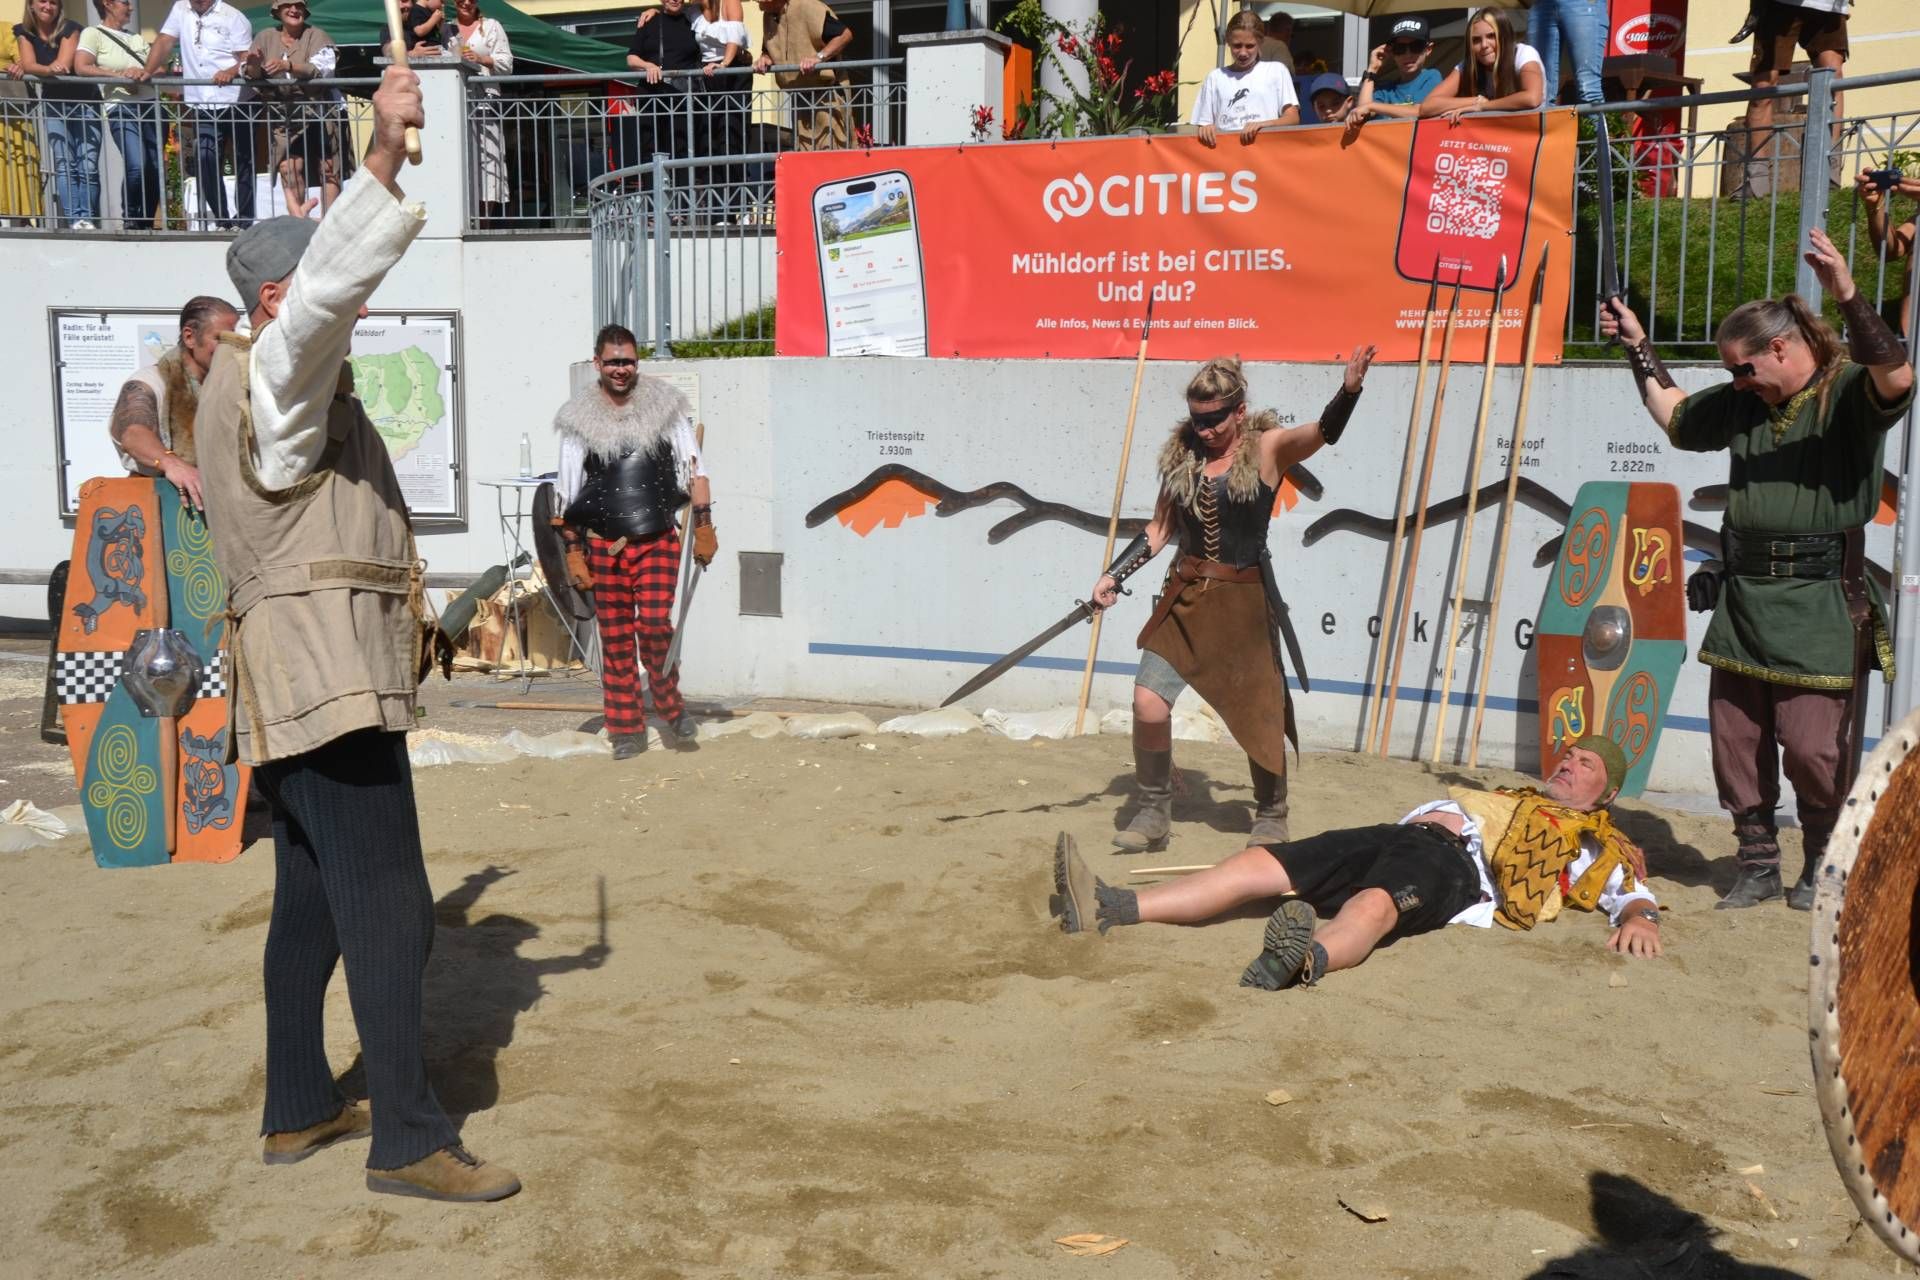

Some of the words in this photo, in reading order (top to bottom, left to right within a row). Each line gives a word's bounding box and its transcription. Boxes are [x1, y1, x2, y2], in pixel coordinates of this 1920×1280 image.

[1440, 140, 1466, 149] JETZT
[1467, 143, 1512, 153] SCANNEN:
[1099, 170, 1258, 217] CITIES
[1012, 251, 1116, 274] Mühldorf
[1122, 252, 1150, 273] ist
[1157, 250, 1196, 272] bei
[1204, 249, 1292, 271] CITIES.
[1098, 280, 1143, 302] Und
[1153, 280, 1196, 302] du?
[1467, 309, 1481, 317] ZU
[1485, 309, 1524, 317] CIES:
[1036, 318, 1057, 329] Alle
[1060, 318, 1090, 331] Infos,
[1092, 318, 1121, 329] News
[1123, 318, 1130, 329] &
[1133, 318, 1170, 329] Events
[1172, 318, 1192, 329] auf
[1194, 318, 1225, 329] einen
[1228, 318, 1260, 329] Blick.
[866, 431, 925, 443] Triestenspitz
[880, 445, 912, 455] 2.930m
[1607, 442, 1660, 454] Riedbock
[1610, 460, 1655, 473] 2.822m
